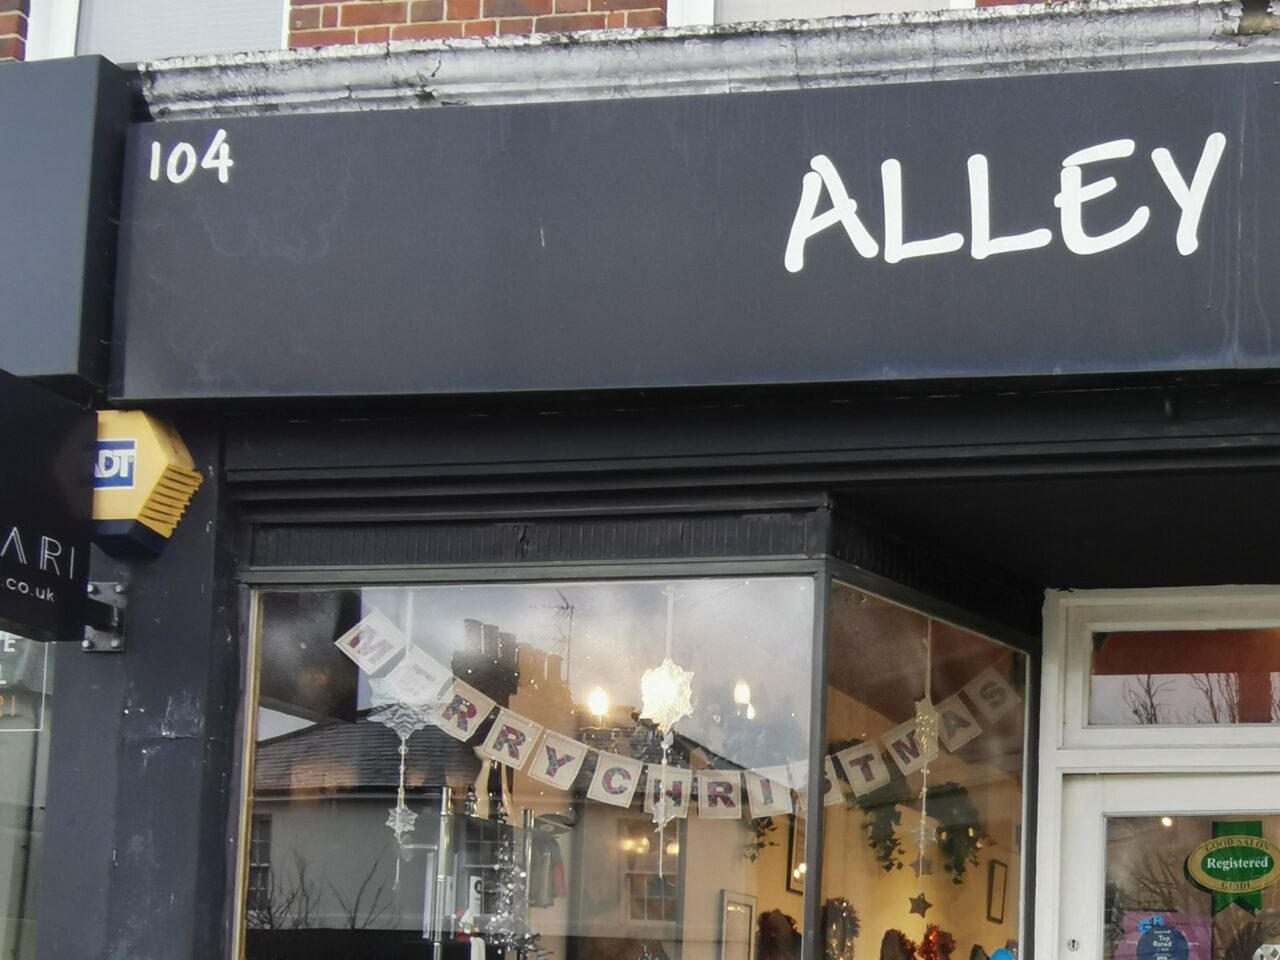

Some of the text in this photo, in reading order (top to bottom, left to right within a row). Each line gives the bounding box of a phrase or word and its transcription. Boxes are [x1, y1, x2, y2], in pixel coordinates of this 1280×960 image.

[150, 129, 234, 183] 104
[785, 132, 1226, 273] ALLEY
[94, 449, 135, 478] DT
[1206, 856, 1269, 871] Registered
